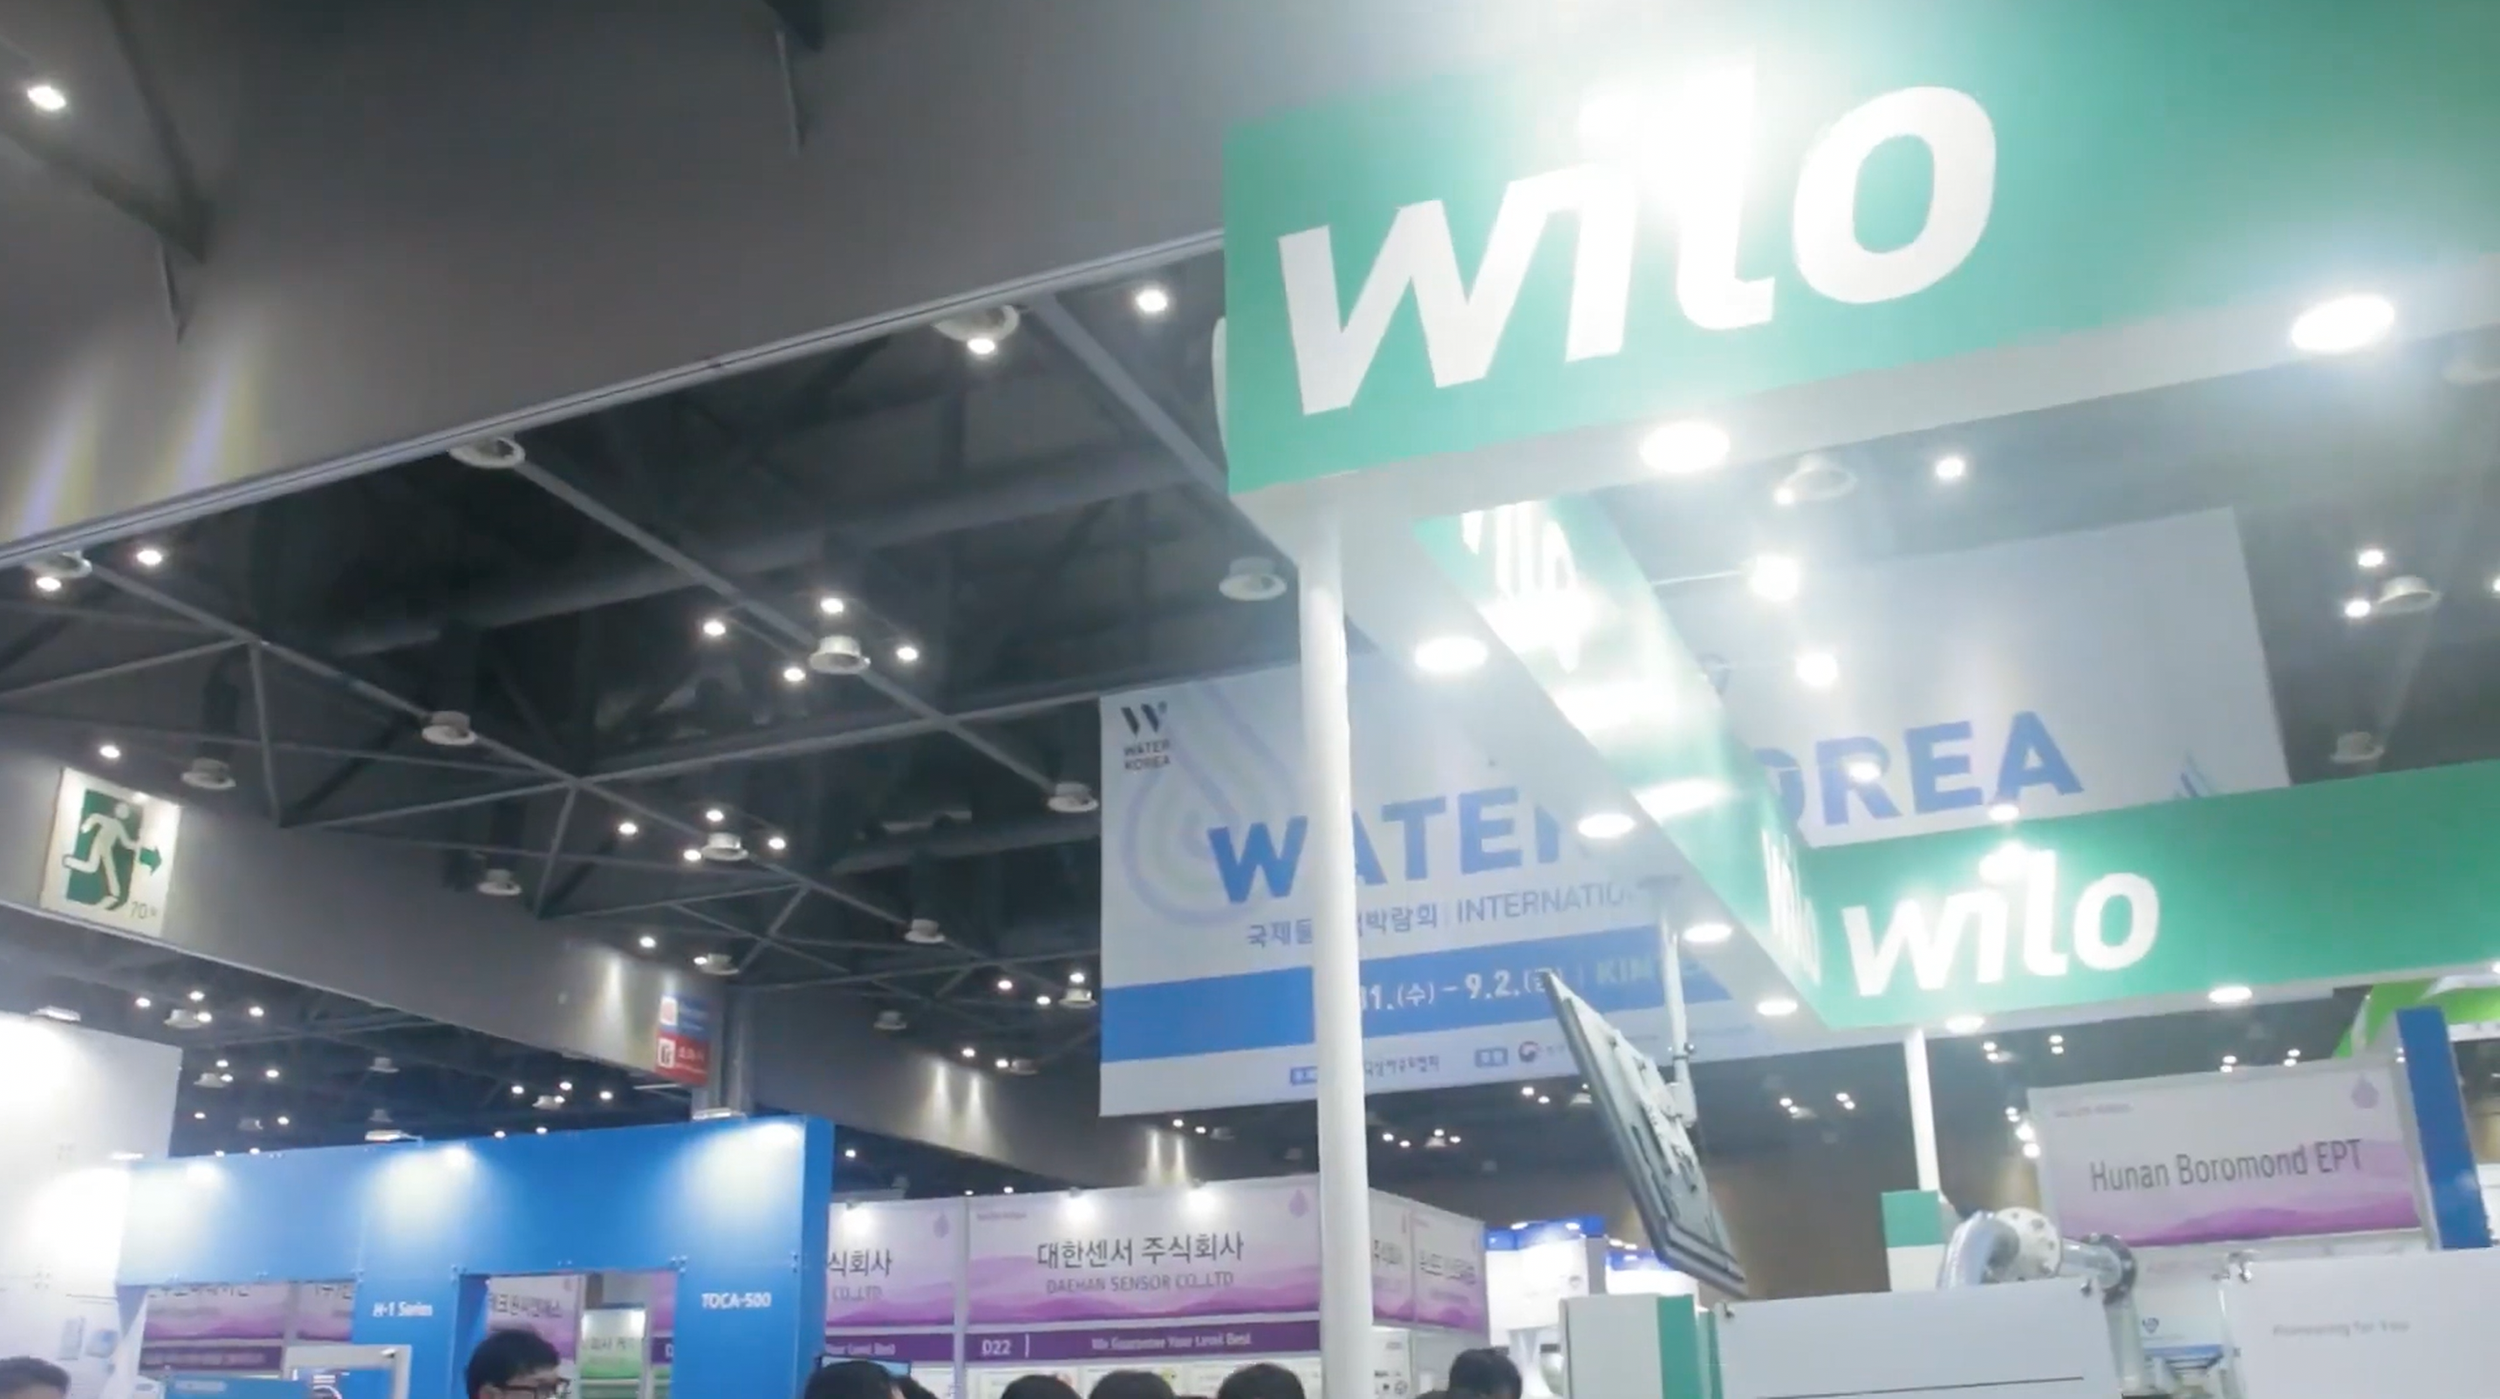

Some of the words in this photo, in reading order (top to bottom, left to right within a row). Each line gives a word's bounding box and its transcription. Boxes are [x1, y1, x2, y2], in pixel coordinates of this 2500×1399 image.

[1279, 62, 1997, 416] wilo
[1124, 739, 1170, 756] WATER
[1125, 755, 1171, 771] KOREA
[1842, 846, 2160, 997] wilo
[2090, 1161, 2170, 1192] Hunan
[2176, 1145, 2307, 1185] Boromond
[2313, 1138, 2363, 1174] EPT
[828, 1249, 893, 1277] 식회사
[1037, 1238, 1134, 1270] 대한센서
[1141, 1231, 1244, 1265] 주식회사
[1046, 1276, 1106, 1294] DAEHAN
[1111, 1273, 1171, 1291] SENSOR
[981, 1339, 1012, 1356] D22
